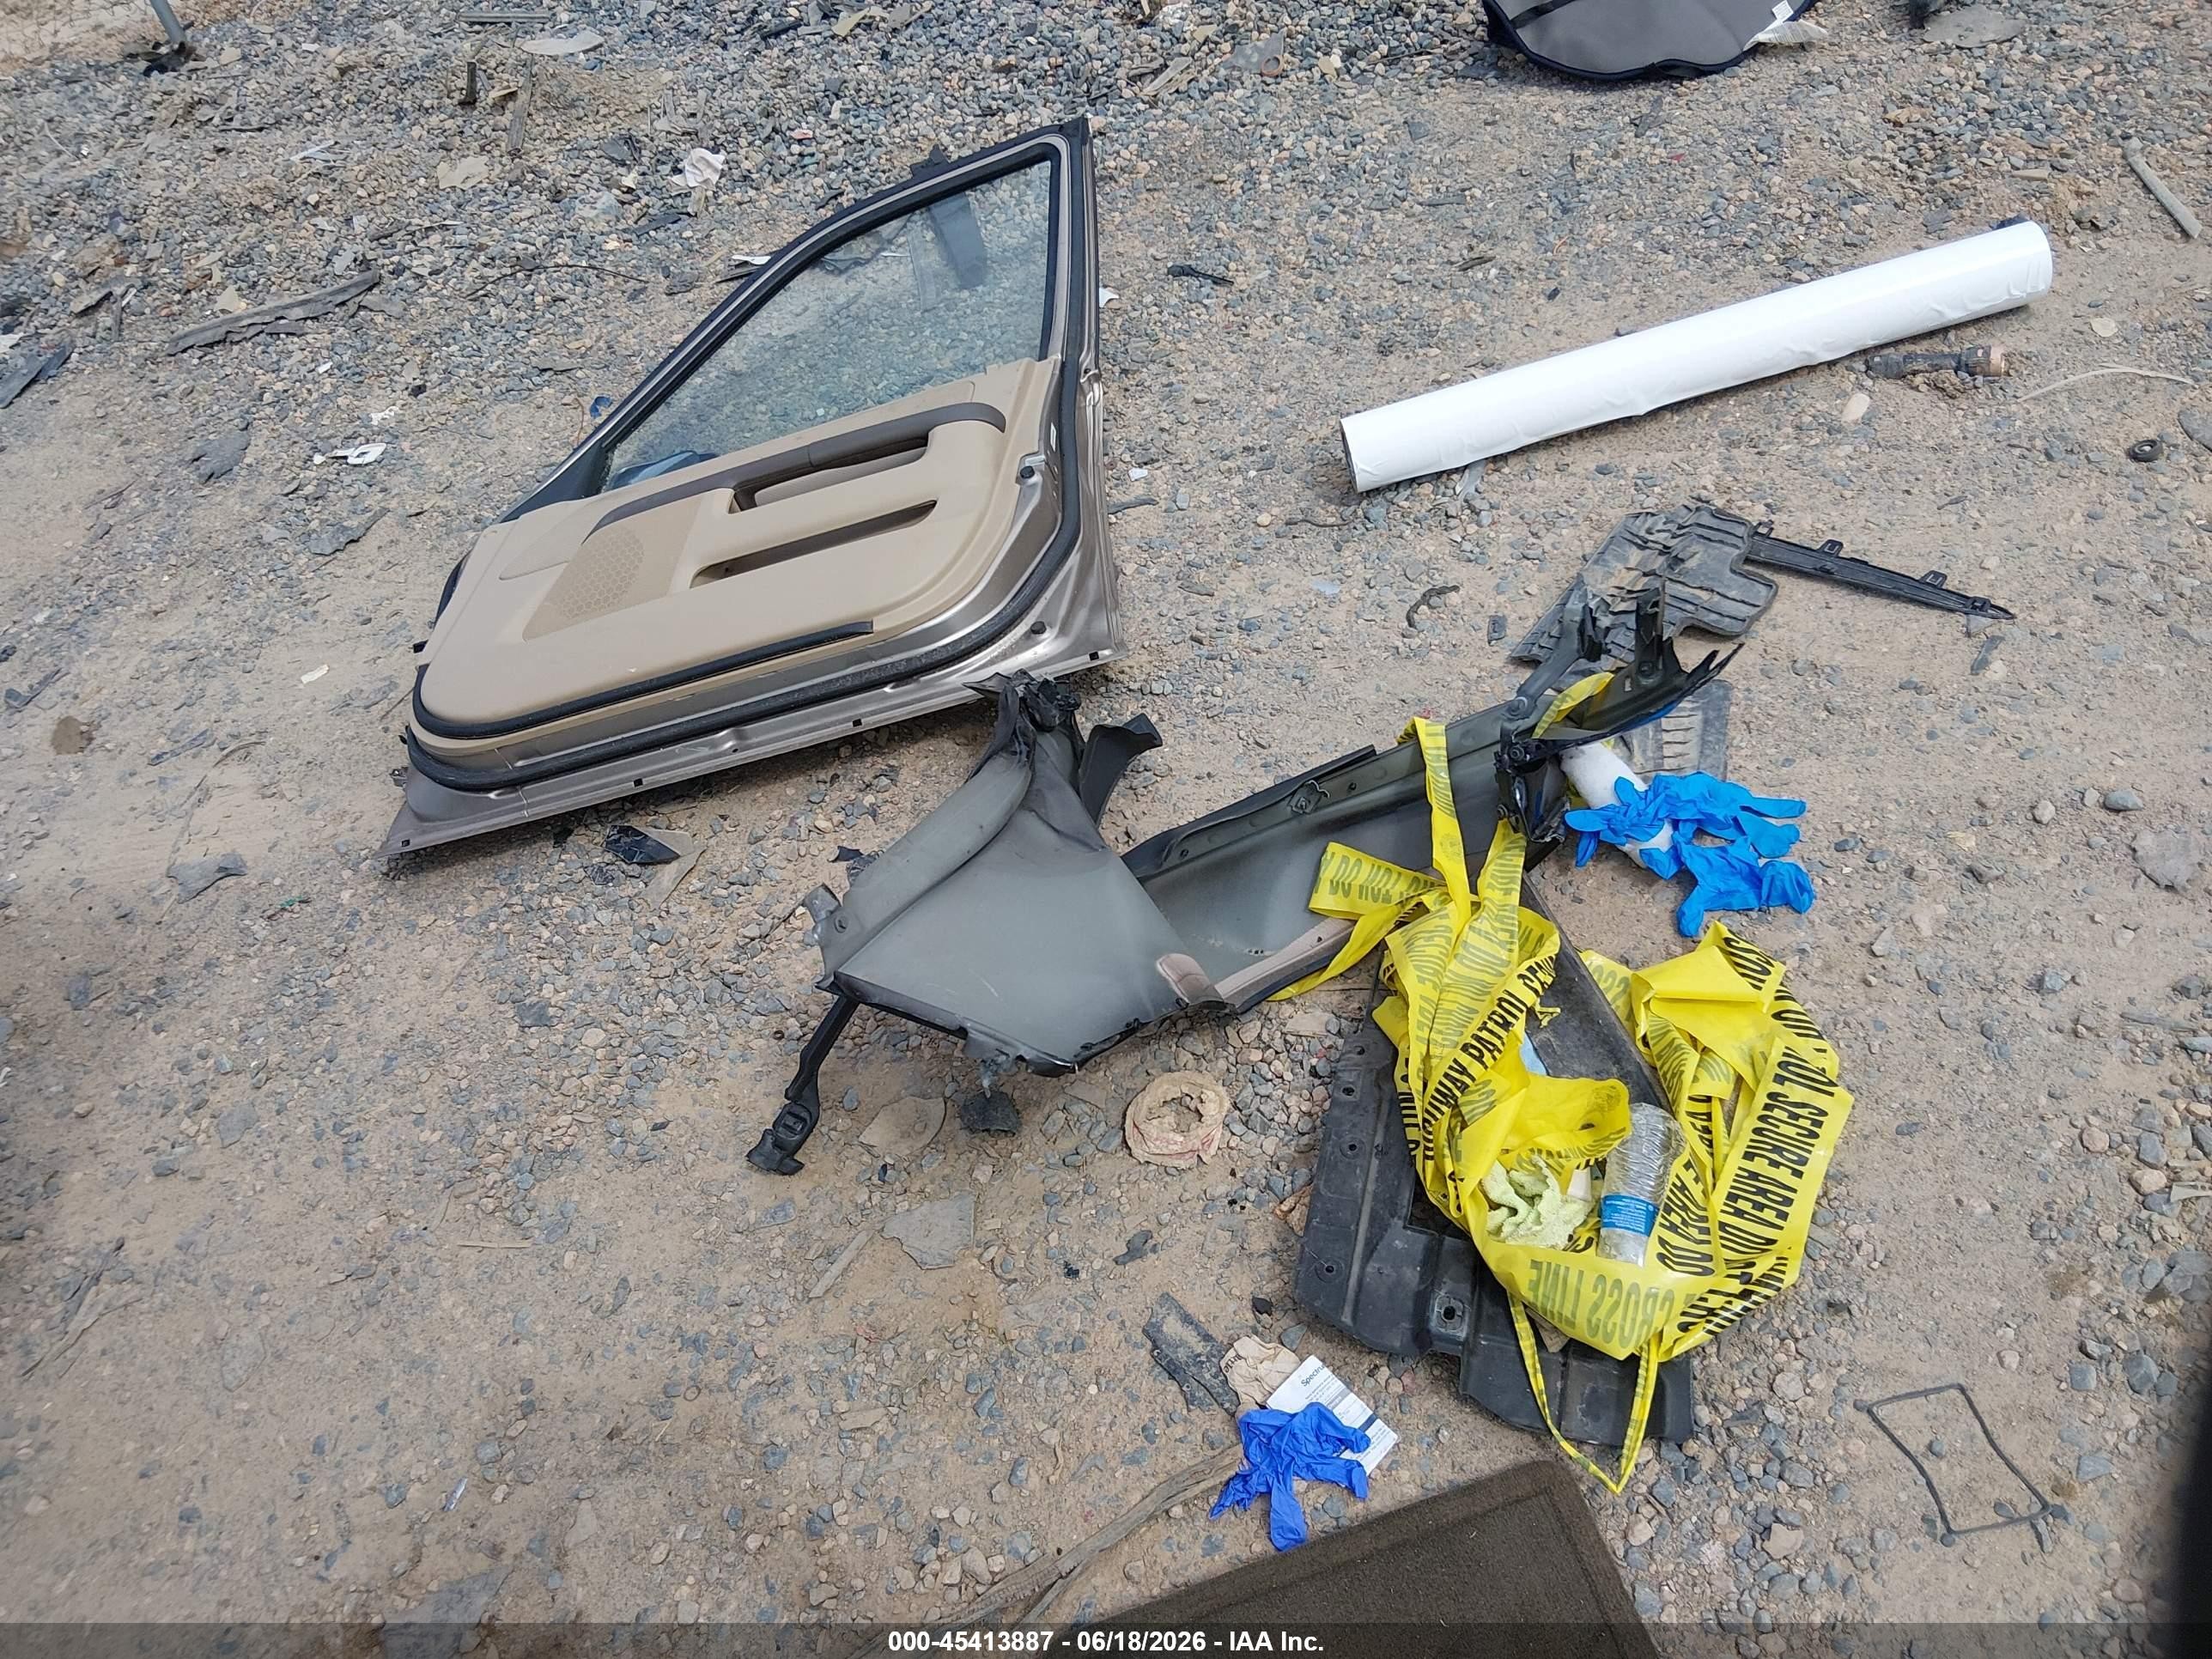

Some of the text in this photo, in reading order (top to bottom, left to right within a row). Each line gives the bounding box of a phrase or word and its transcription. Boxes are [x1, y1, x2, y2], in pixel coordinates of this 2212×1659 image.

[1741, 1091, 1829, 1180] SECURE
[1659, 1173, 1712, 1245] AREA
[1720, 1165, 1798, 1231] AREA
[1656, 1235, 1716, 1277] DO
